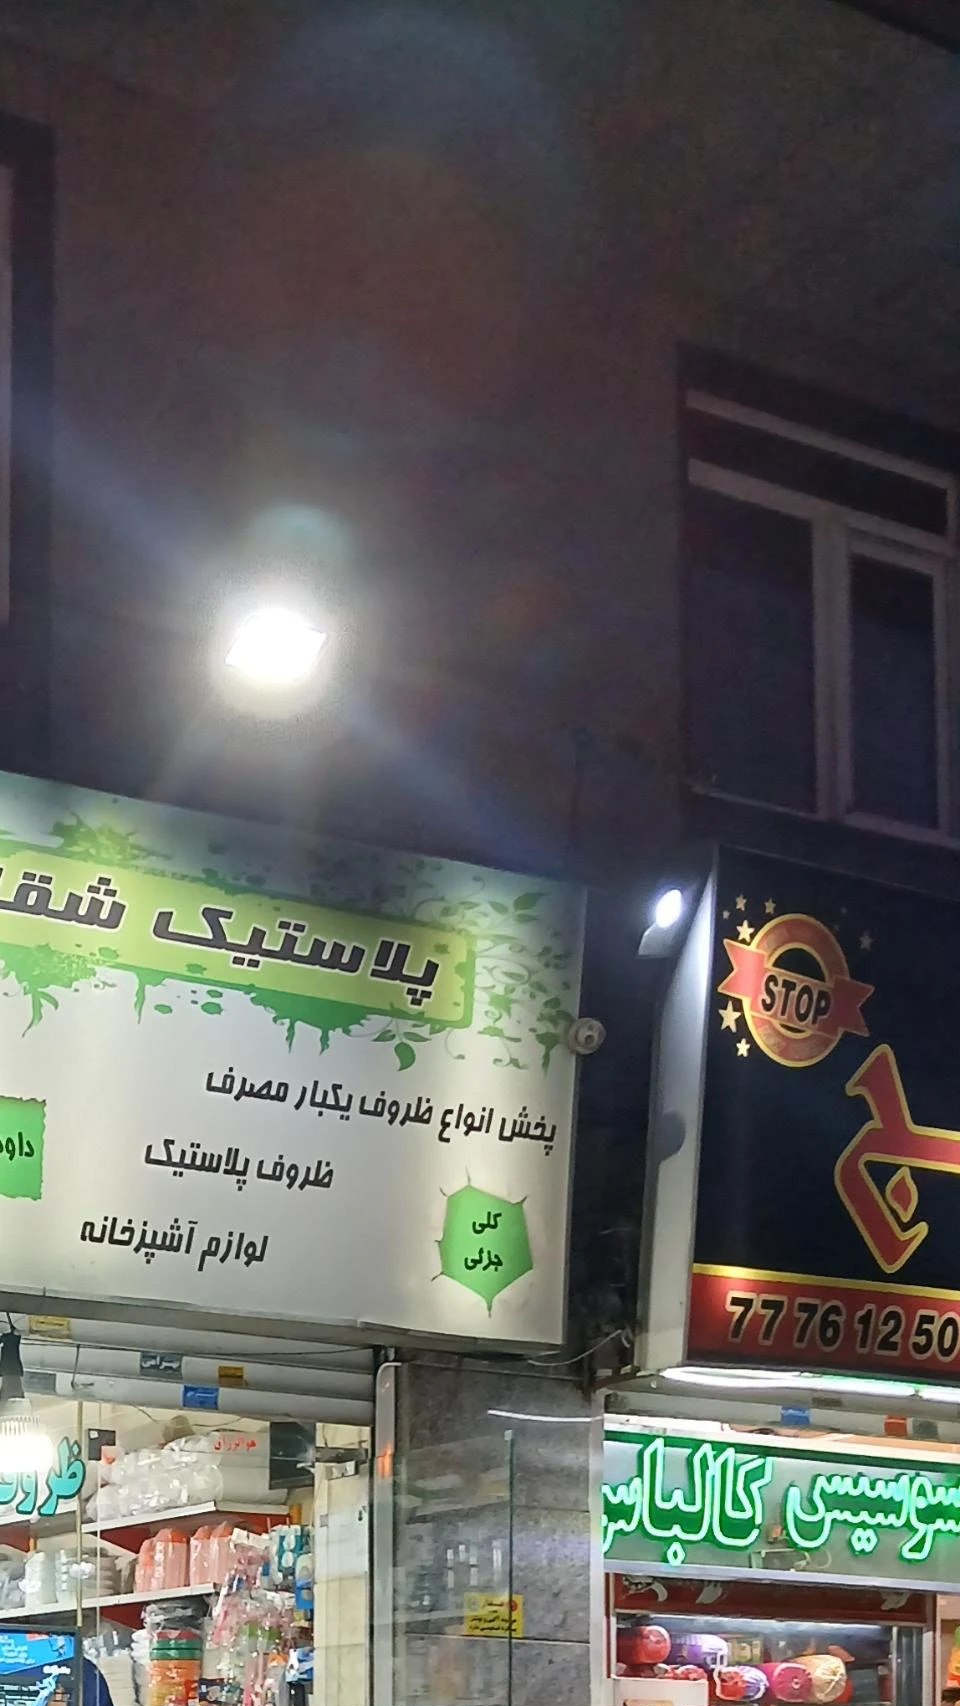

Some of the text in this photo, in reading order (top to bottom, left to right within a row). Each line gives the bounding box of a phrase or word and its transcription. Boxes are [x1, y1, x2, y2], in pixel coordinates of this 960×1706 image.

[152, 906, 440, 1006] پلاستیک
[760, 974, 832, 1025] STOP
[205, 1067, 557, 1156] پخش انواع ظروف یکبار مصرف
[144, 1138, 334, 1191] ظروف پلاستیک
[80, 1216, 269, 1271] لوازم آشپزخانه
[472, 1211, 502, 1234] کلی
[727, 1293, 960, 1359] 77 76 12 50
